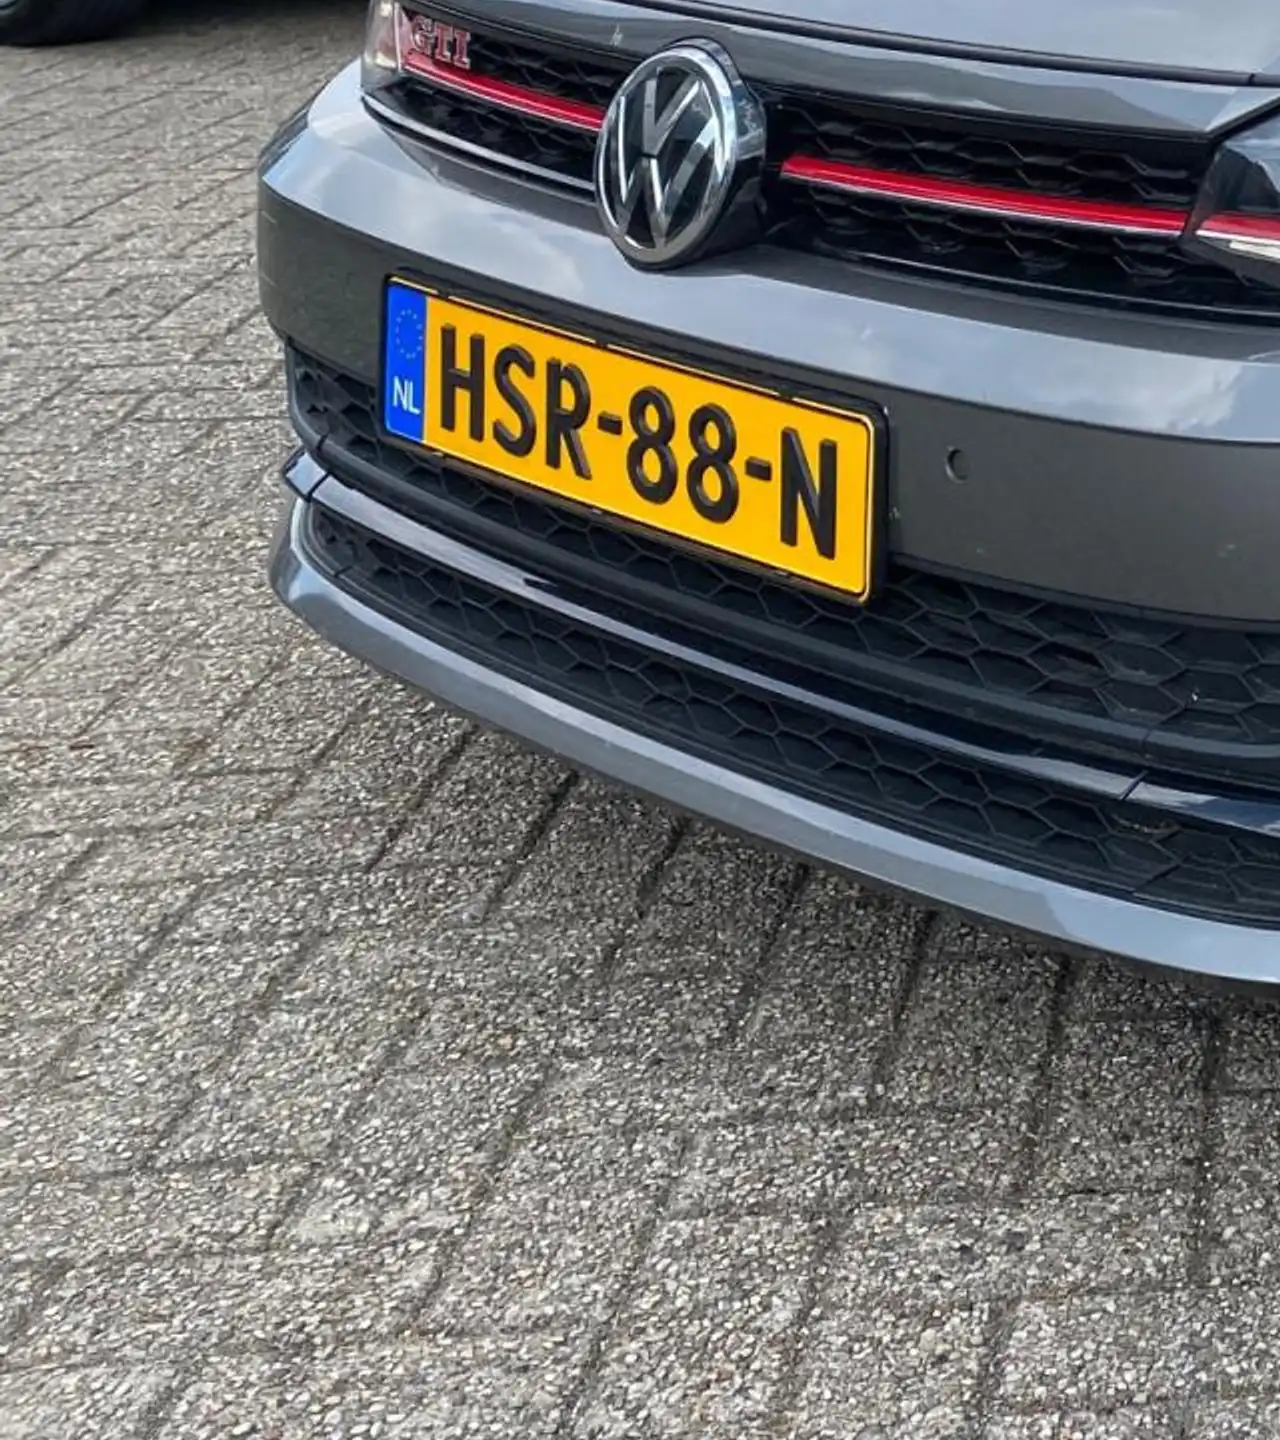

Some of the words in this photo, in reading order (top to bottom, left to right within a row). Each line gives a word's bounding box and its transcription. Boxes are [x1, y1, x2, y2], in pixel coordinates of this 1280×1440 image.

[411, 15, 471, 70] GTI
[392, 375, 421, 416] NL
[440, 322, 838, 561] HSR-88-N
